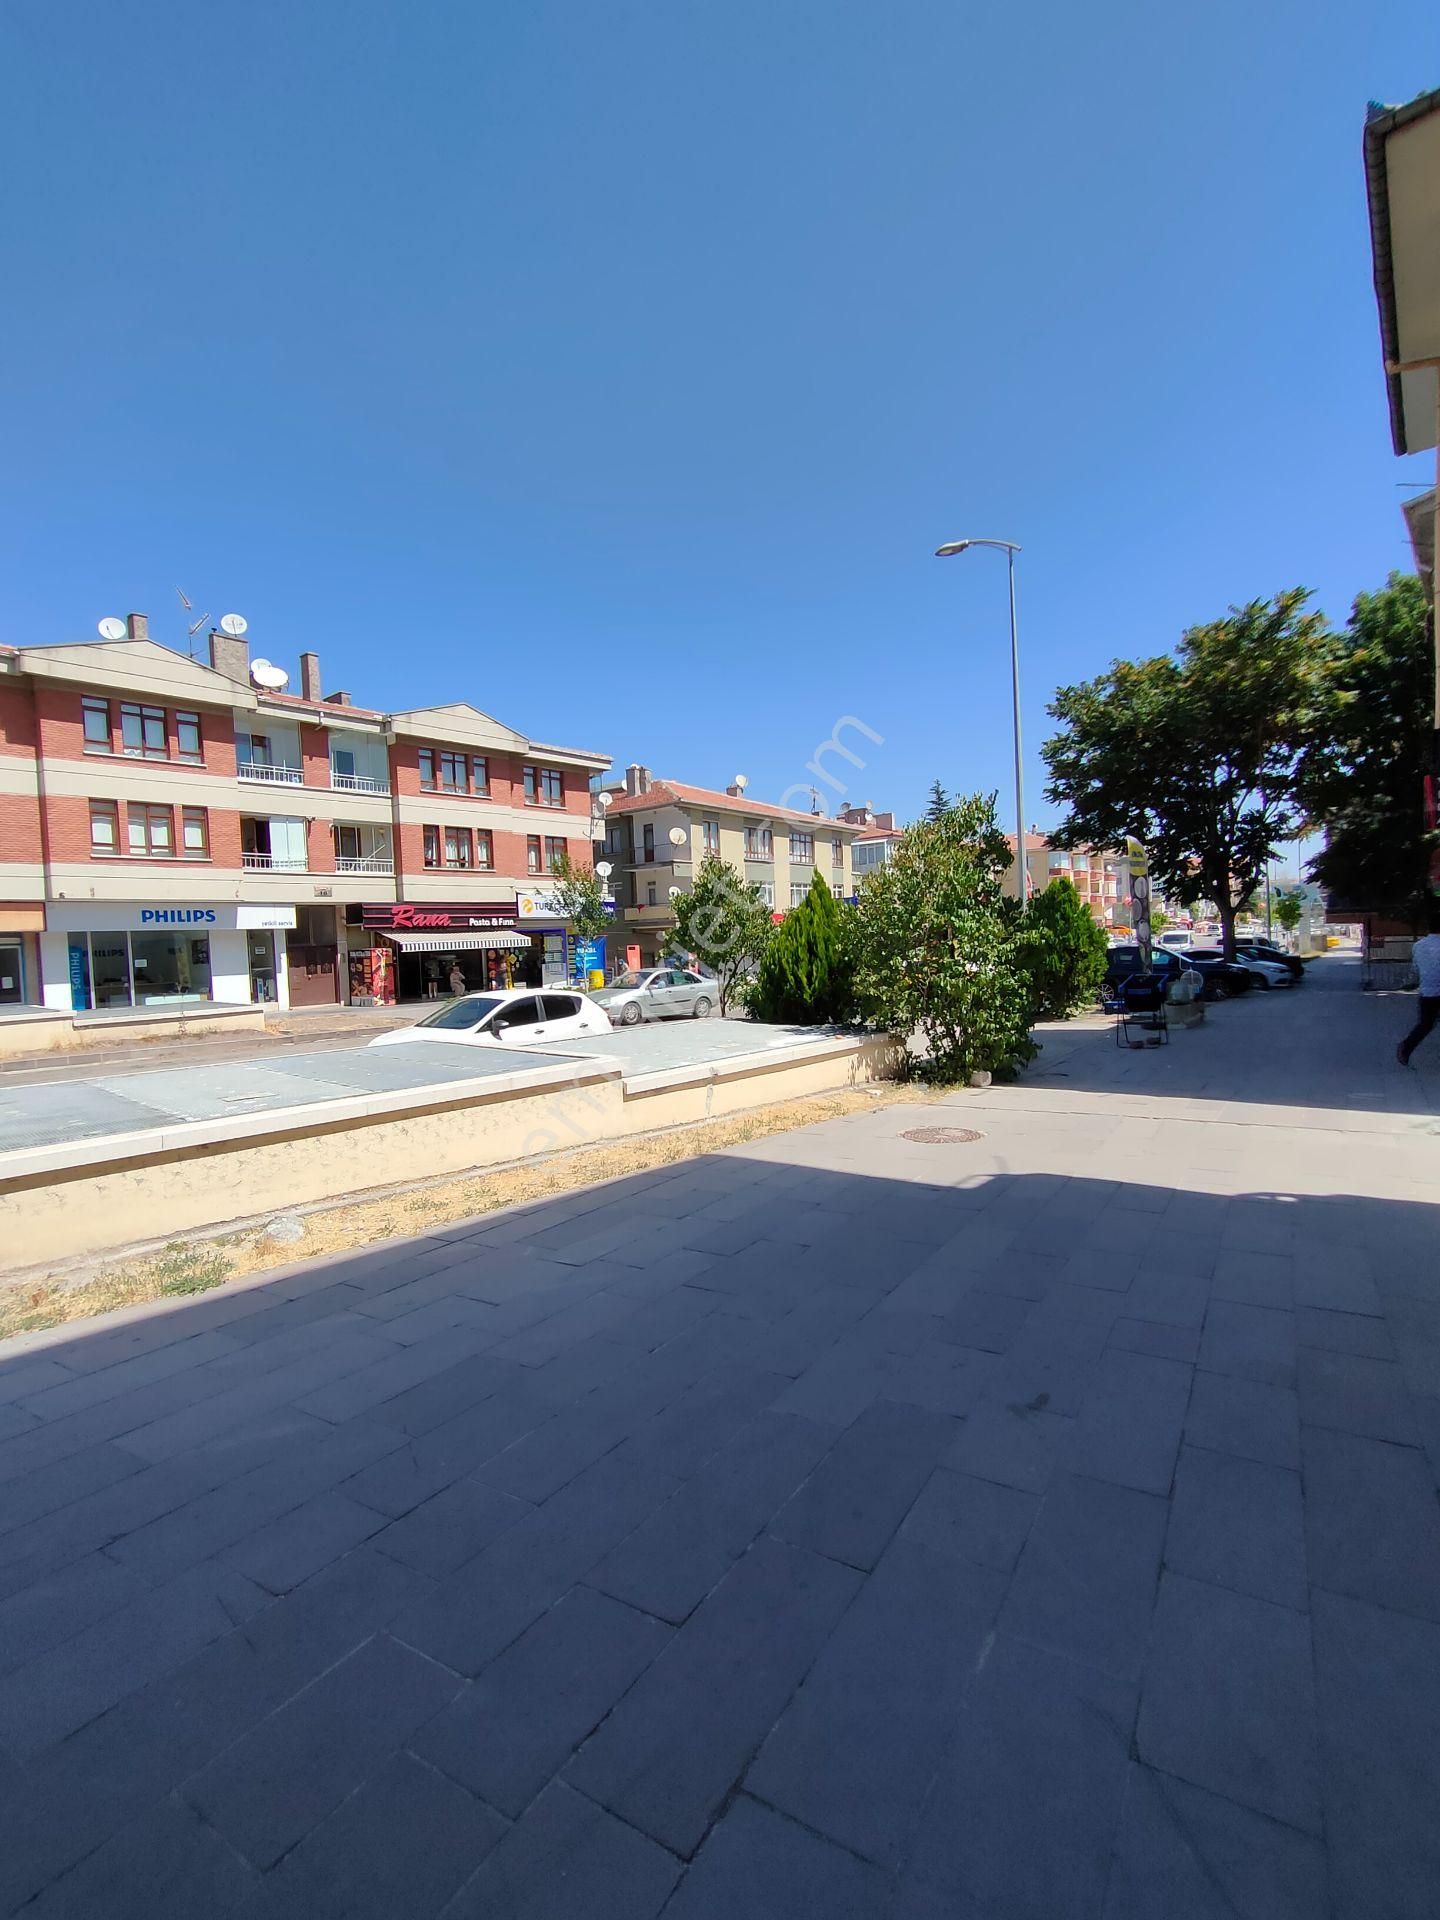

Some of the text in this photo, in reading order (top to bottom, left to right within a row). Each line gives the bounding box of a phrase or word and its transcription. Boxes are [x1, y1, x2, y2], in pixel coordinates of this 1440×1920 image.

[141, 909, 216, 923] PHILIPS
[391, 904, 451, 928] Rana
[468, 917, 490, 926] Pasta
[491, 917, 498, 926] &
[70, 952, 81, 990] PHILIPS
